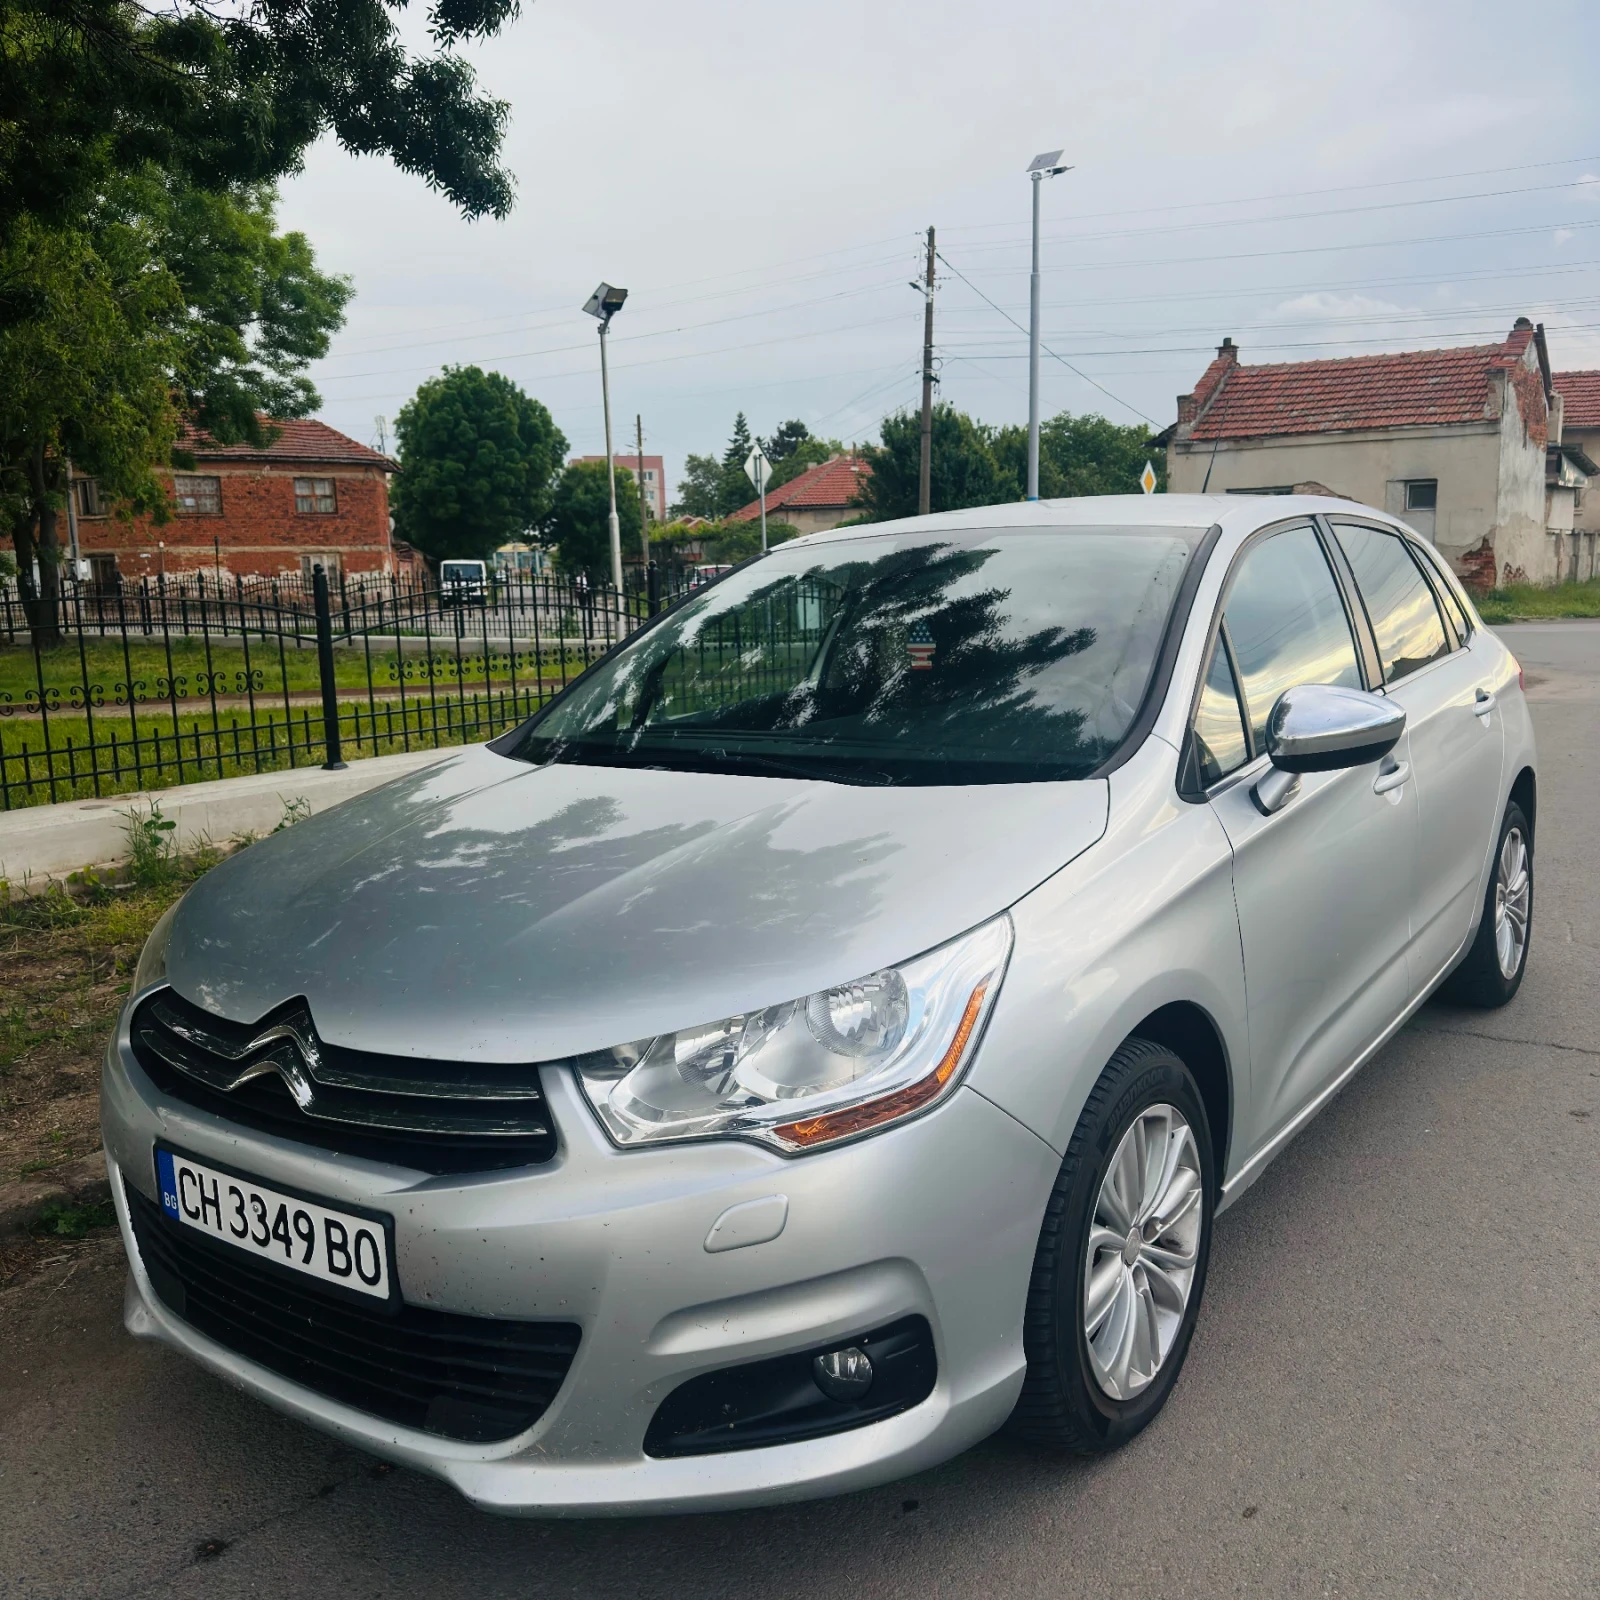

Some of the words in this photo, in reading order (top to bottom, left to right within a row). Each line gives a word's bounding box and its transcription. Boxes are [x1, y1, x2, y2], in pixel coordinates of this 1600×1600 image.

[163, 1192, 178, 1210] BG
[179, 1167, 223, 1231] CH
[229, 1186, 315, 1265] 3349
[324, 1218, 381, 1286] BO
